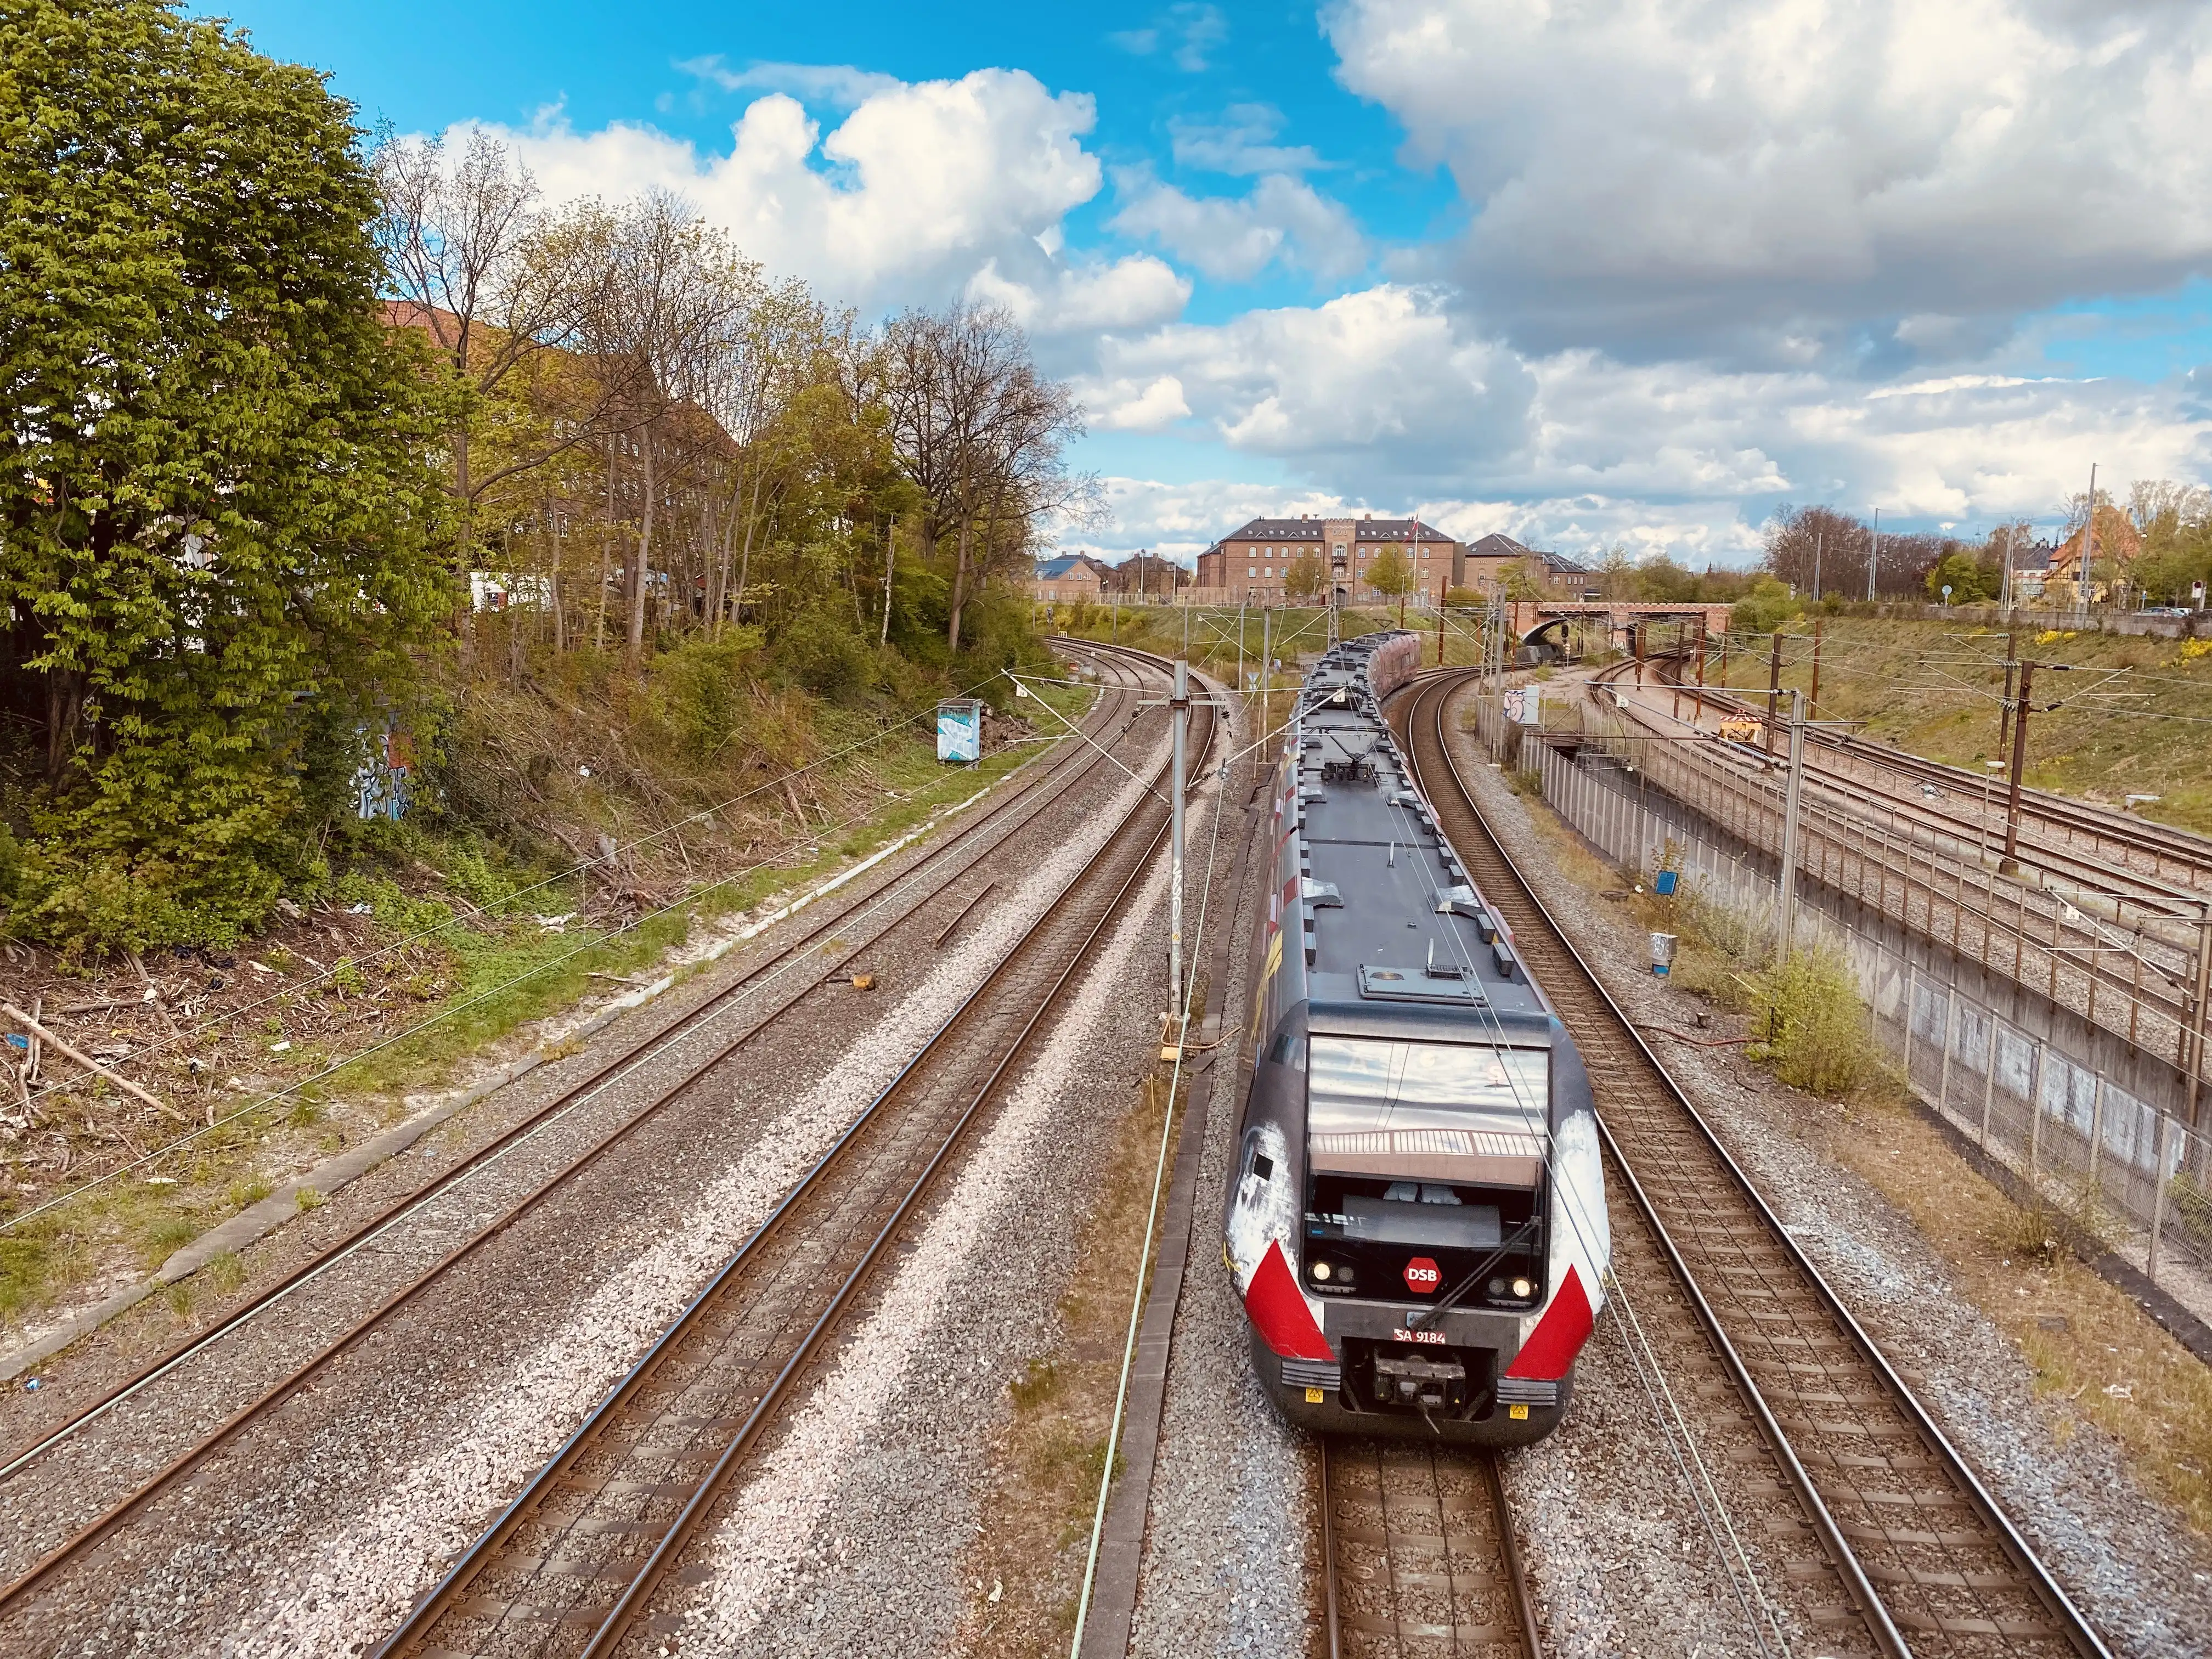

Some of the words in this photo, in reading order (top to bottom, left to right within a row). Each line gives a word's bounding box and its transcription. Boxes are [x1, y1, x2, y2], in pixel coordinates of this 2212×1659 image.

[1408, 1268, 1437, 1282] DSB
[1395, 1329, 1412, 1341] SA
[1416, 1331, 1446, 1344] 9184
